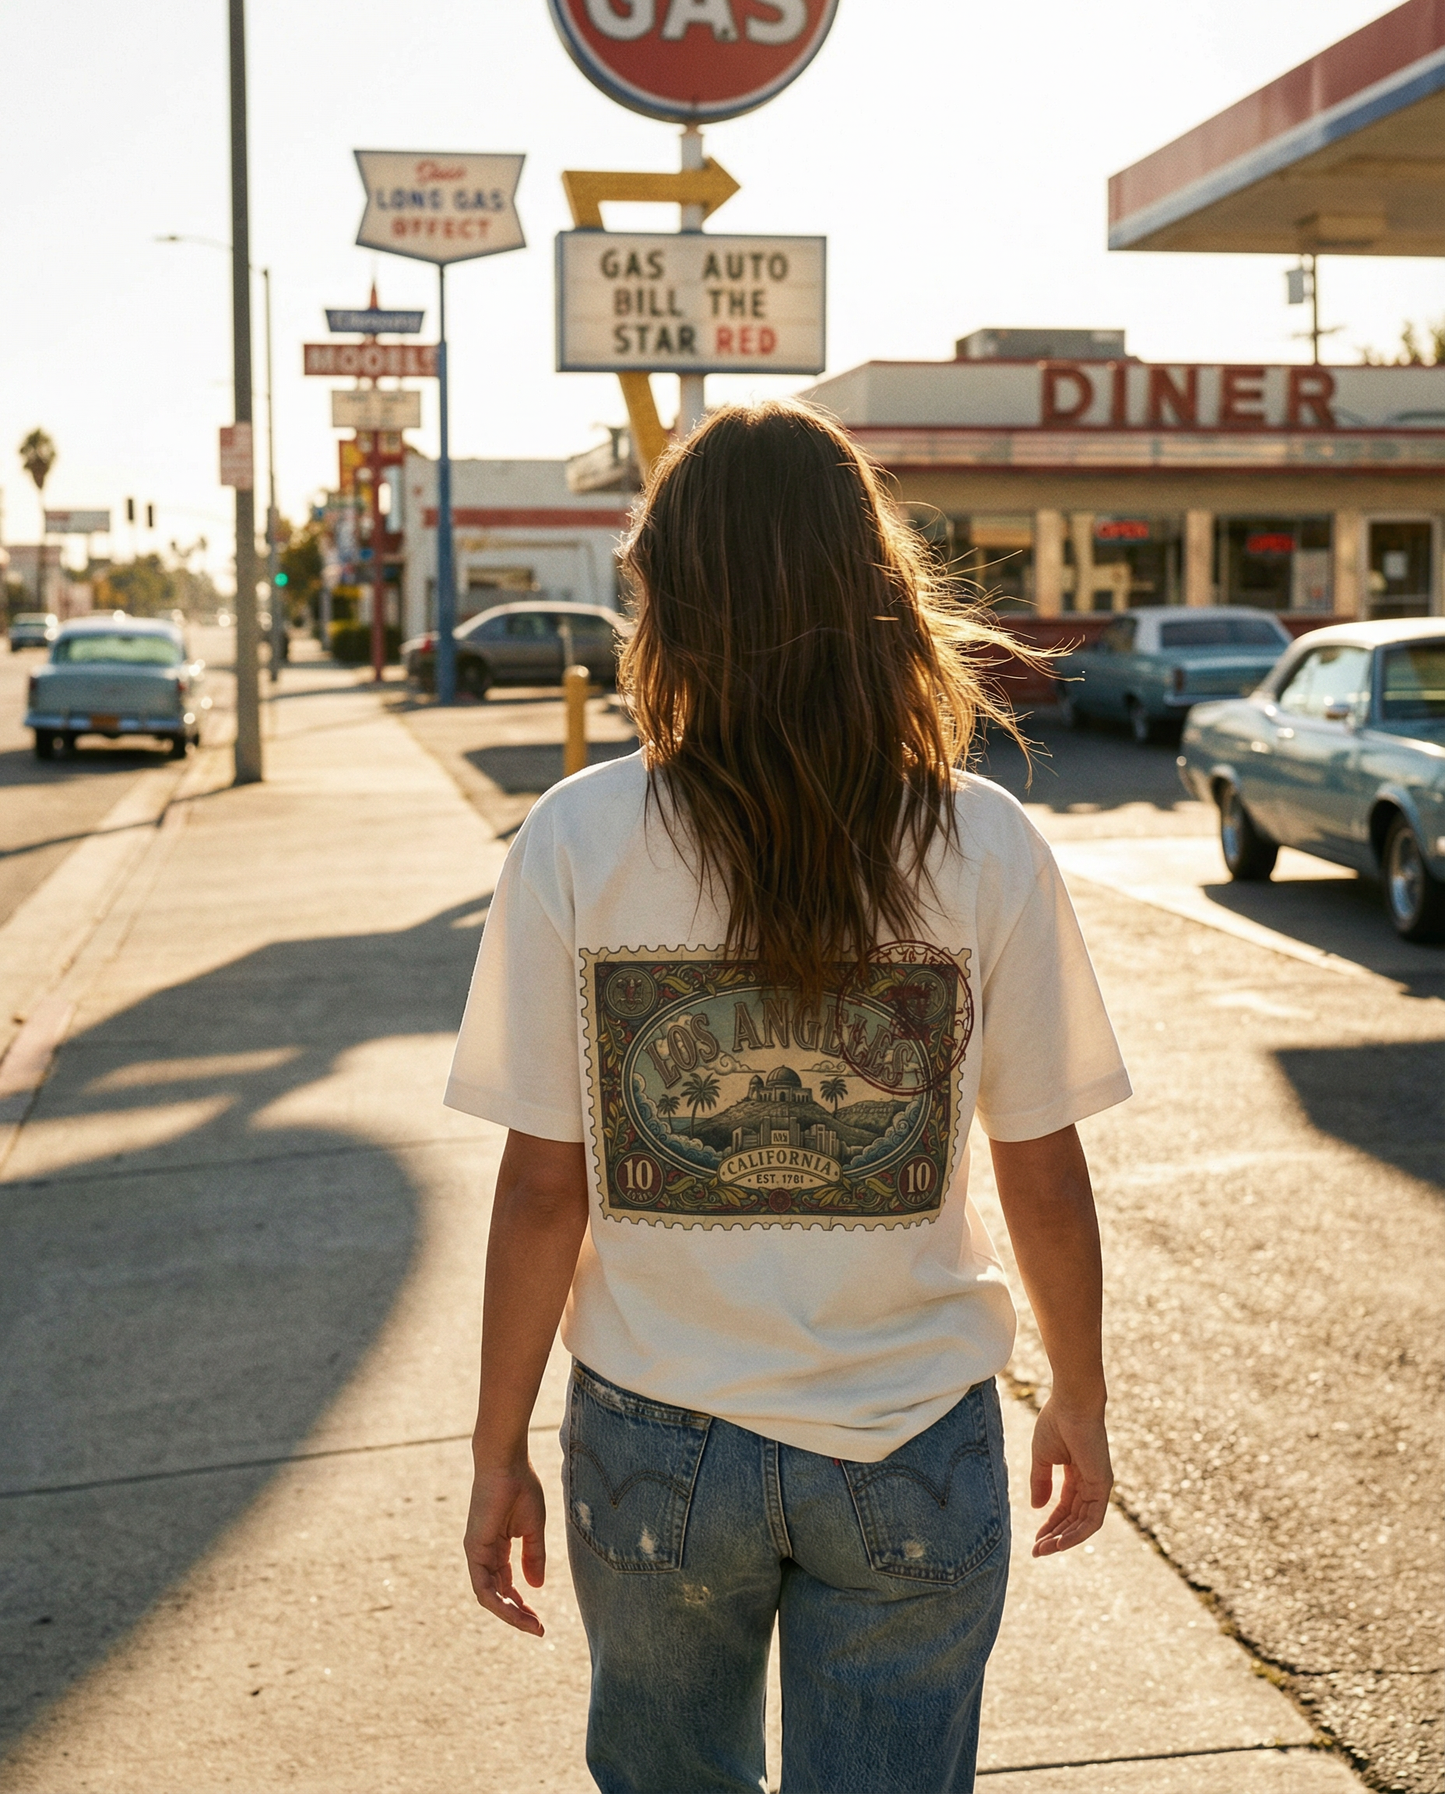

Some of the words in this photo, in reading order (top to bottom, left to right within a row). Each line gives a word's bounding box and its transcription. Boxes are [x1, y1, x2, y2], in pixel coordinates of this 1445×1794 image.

[453, 188, 504, 212] GAS
[601, 250, 664, 280] GAS
[703, 251, 789, 282] AUTO
[614, 288, 682, 318] BILL
[706, 289, 766, 319] THE
[613, 325, 697, 355] STAR
[716, 326, 778, 356] RED
[1041, 365, 1337, 428] DINER
[646, 1012, 721, 1089] LOS
[732, 997, 918, 1087] ANGELES
[623, 1158, 654, 1190] 10
[726, 1149, 832, 1177] CALIFORNIA
[906, 1162, 931, 1193] 10
